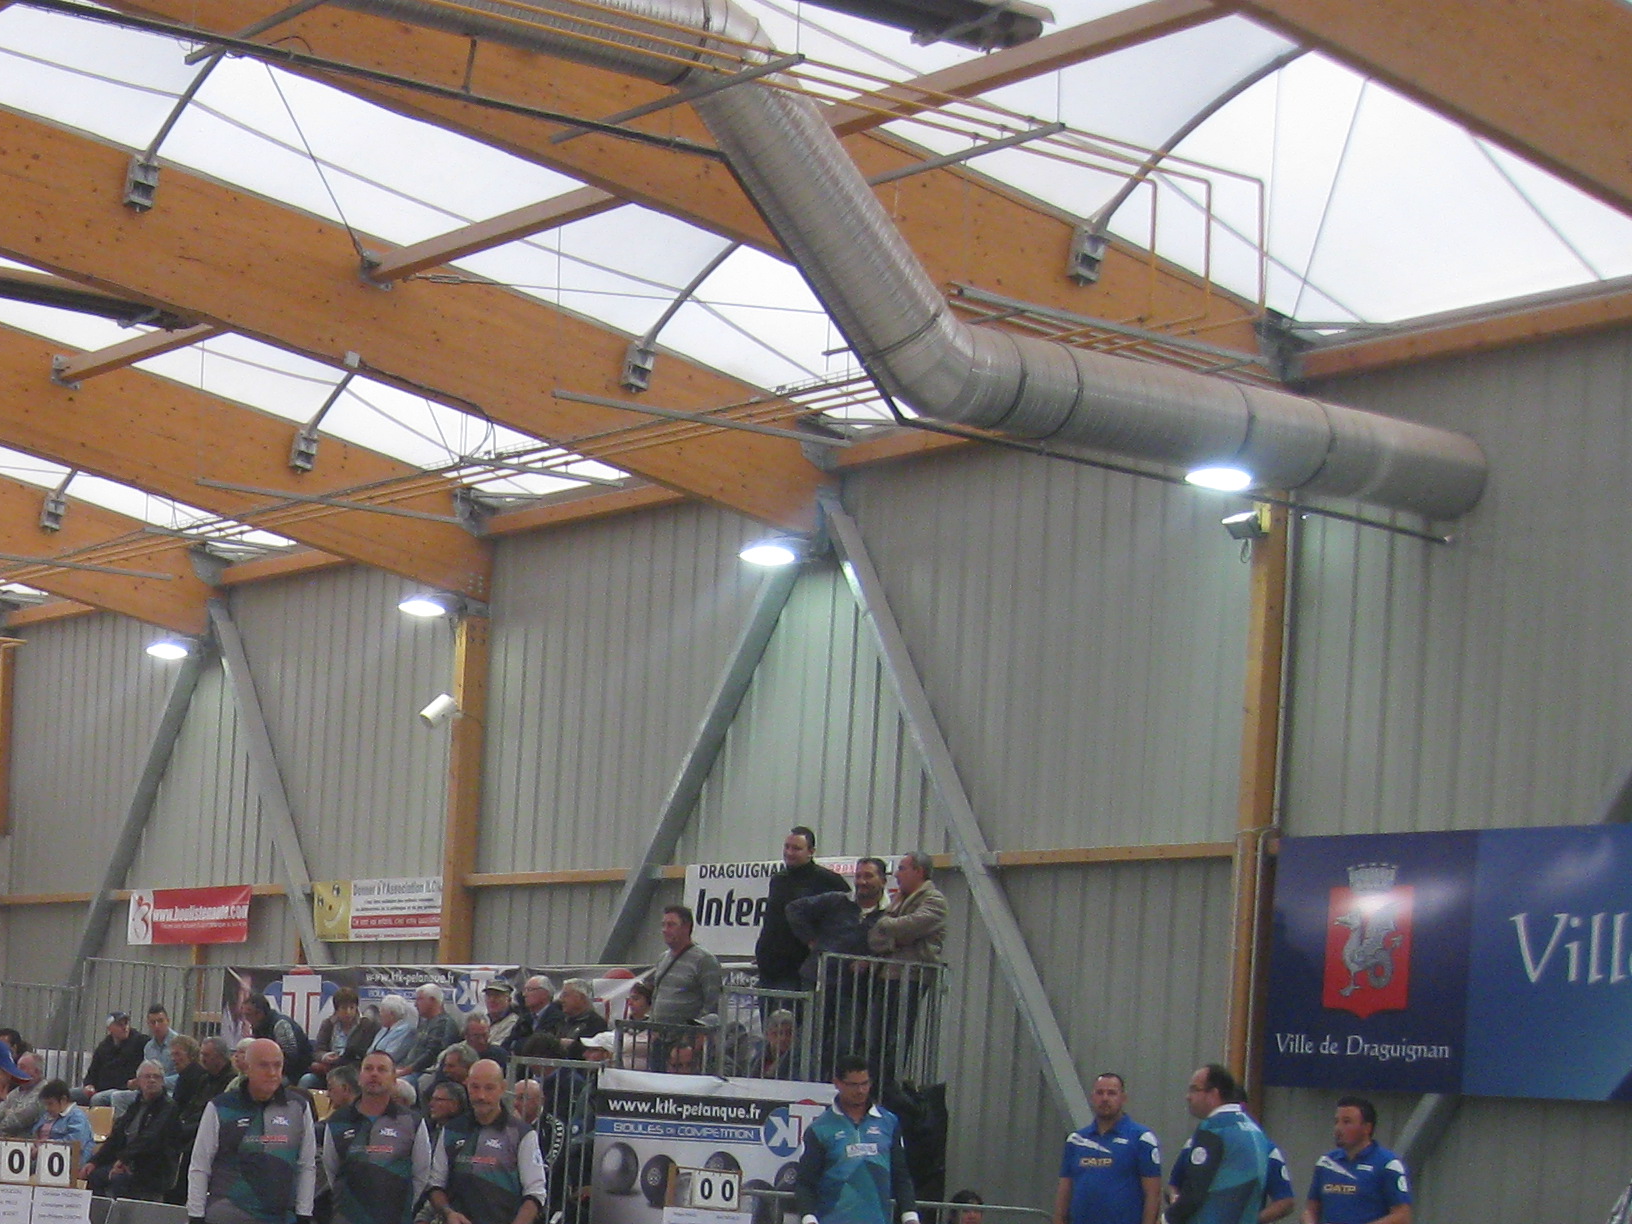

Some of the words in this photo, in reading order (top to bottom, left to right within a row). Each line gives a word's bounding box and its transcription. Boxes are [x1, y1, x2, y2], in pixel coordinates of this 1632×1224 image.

[696, 888, 768, 927] Inter
[1509, 912, 1632, 985] Vill
[1276, 1033, 1314, 1054] Ville
[1319, 1035, 1338, 1055] de
[1346, 1034, 1450, 1062] Draguignan
[608, 1097, 761, 1121] www.ktk-petanque.fr
[614, 1121, 663, 1134] BOULES
[8, 1149, 25, 1174] 0
[48, 1152, 64, 1177] 0
[700, 1178, 713, 1200] 0
[721, 1179, 734, 1202] 0
